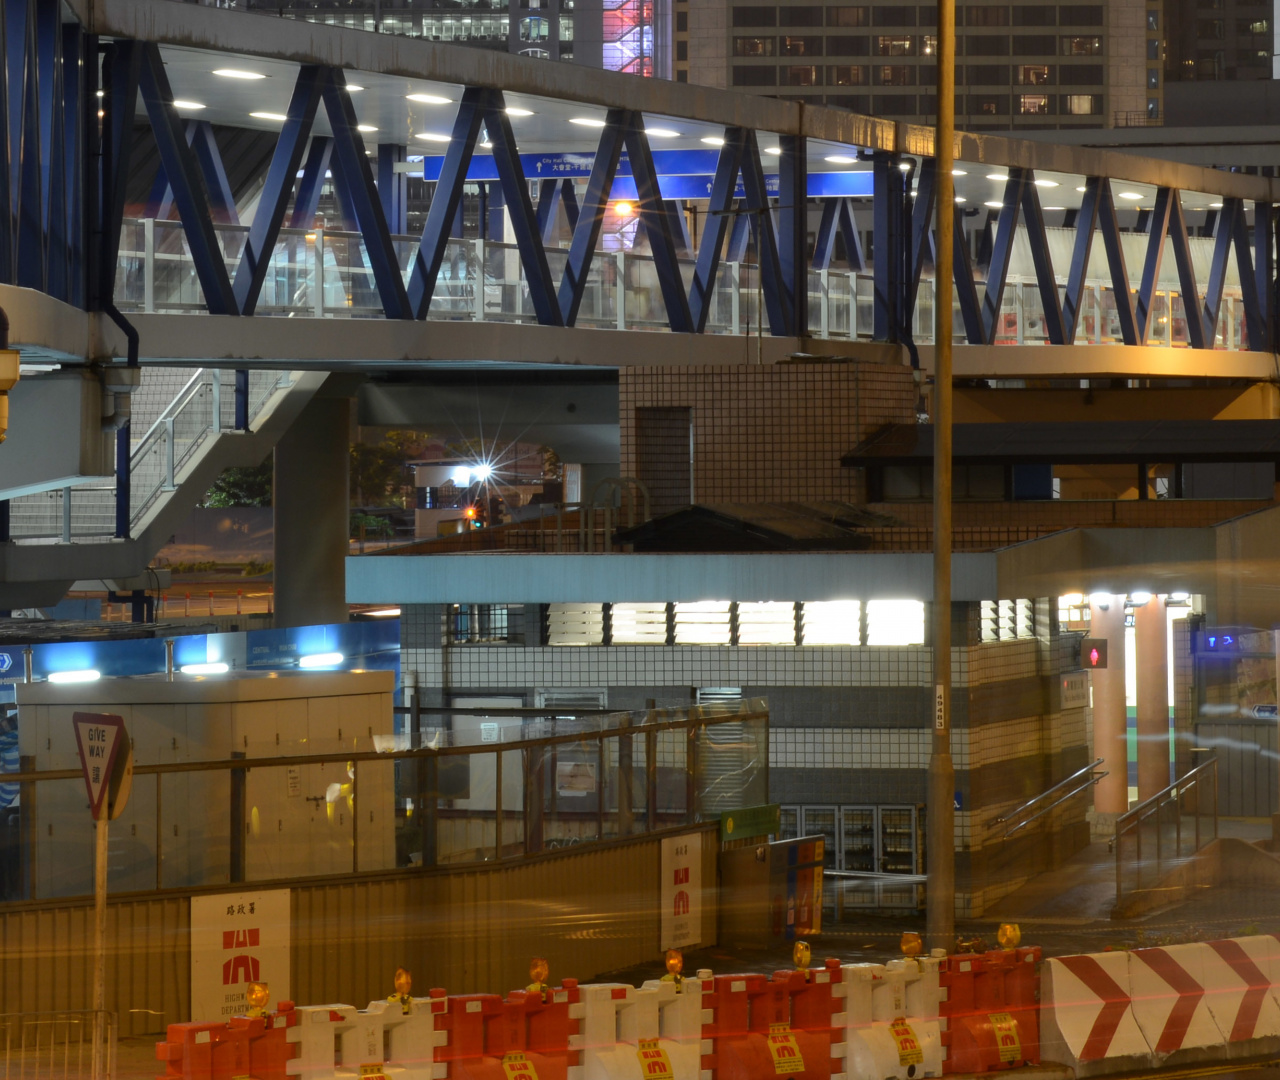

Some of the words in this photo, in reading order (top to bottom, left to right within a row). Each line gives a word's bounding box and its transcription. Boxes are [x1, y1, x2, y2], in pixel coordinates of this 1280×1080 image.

[88, 728, 106, 742] GIVE
[88, 745, 105, 758] WAY
[226, 902, 256, 916] 路政署
